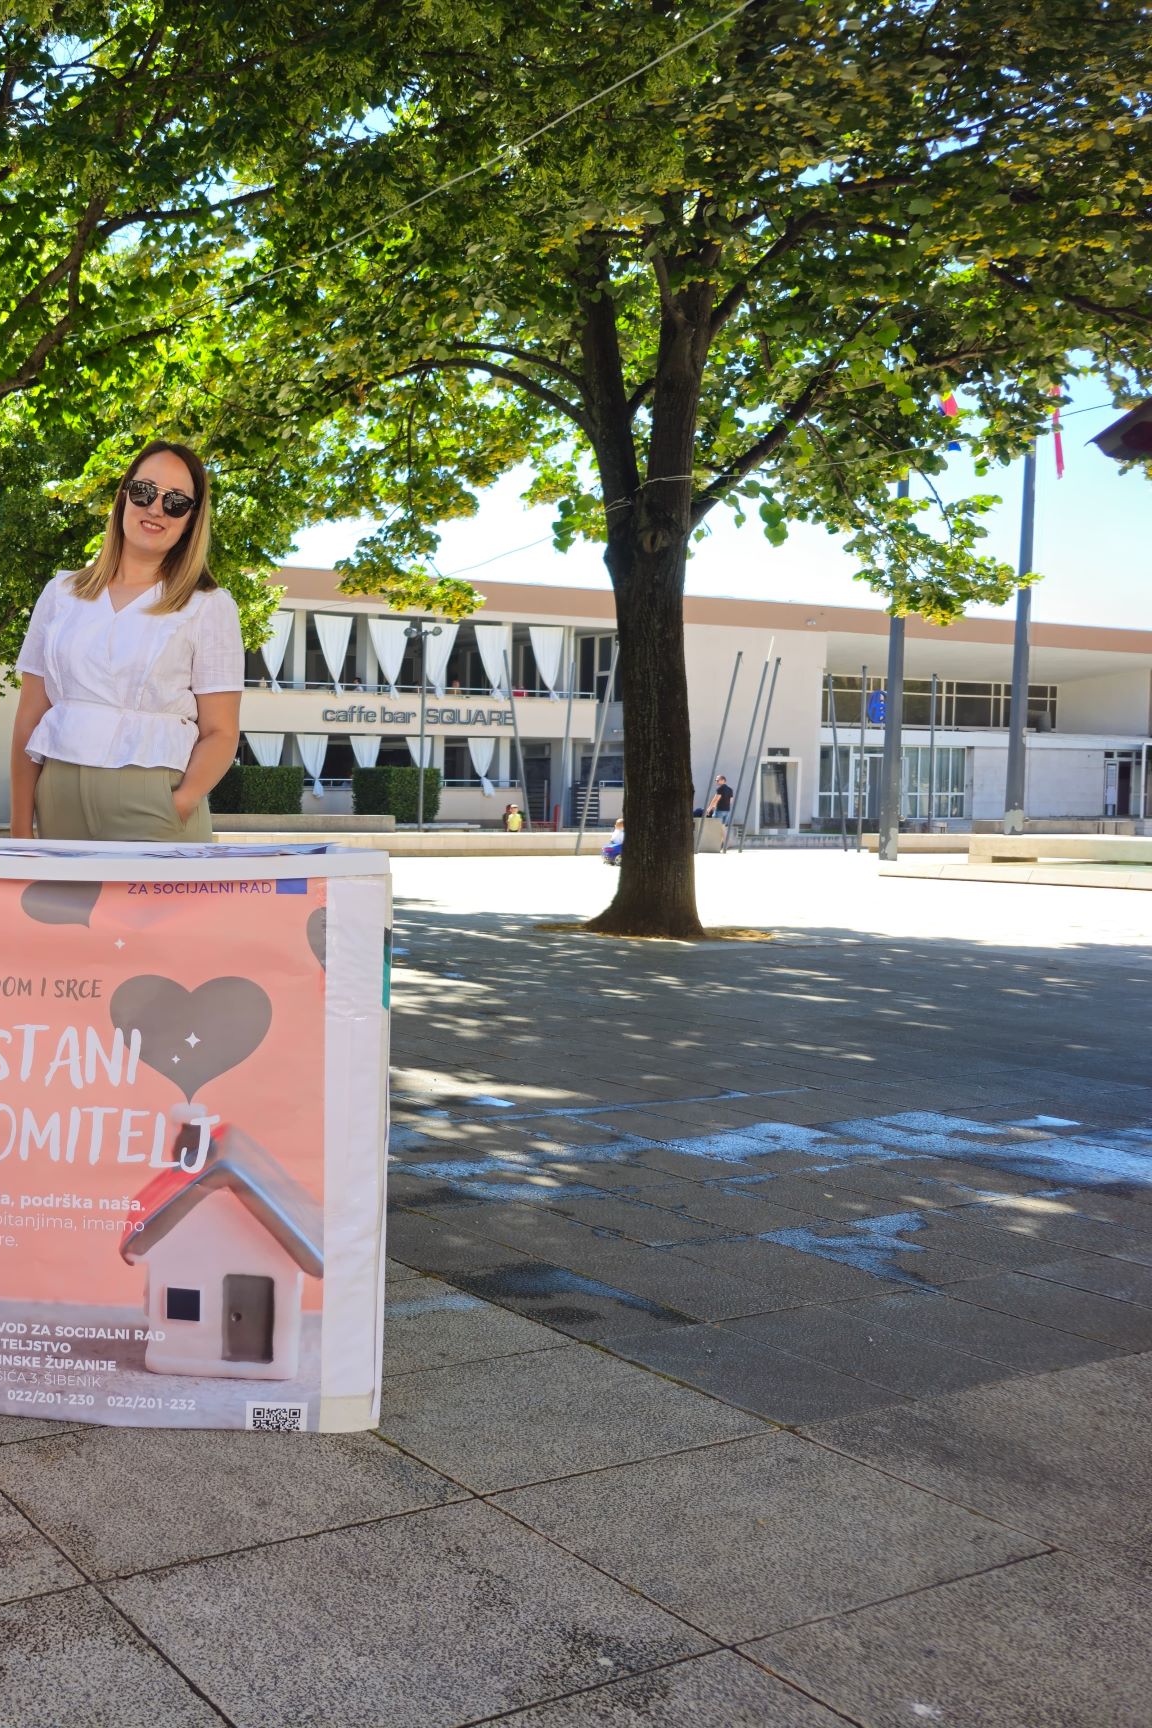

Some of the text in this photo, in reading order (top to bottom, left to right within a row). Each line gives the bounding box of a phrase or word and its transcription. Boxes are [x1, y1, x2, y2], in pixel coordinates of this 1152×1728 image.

[322, 705, 515, 726] caffe bar SQUARE
[127, 882, 272, 895] ZA SOCIJALNI RAD
[40, 977, 47, 998] I
[53, 978, 103, 1000] SRCE
[20, 1191, 93, 1211] podrška
[98, 1193, 146, 1212] naša.
[82, 1215, 145, 1232] imamo
[31, 1323, 51, 1336] ZA
[54, 1325, 130, 1341] SOCIJALNI
[134, 1329, 166, 1342] RAD
[45, 1352, 117, 1372] ŽUPANIJE
[43, 1370, 102, 1388] ŠIBENIK
[7, 1389, 95, 1407] 022/201-230
[107, 1394, 196, 1412] 022/201-232
